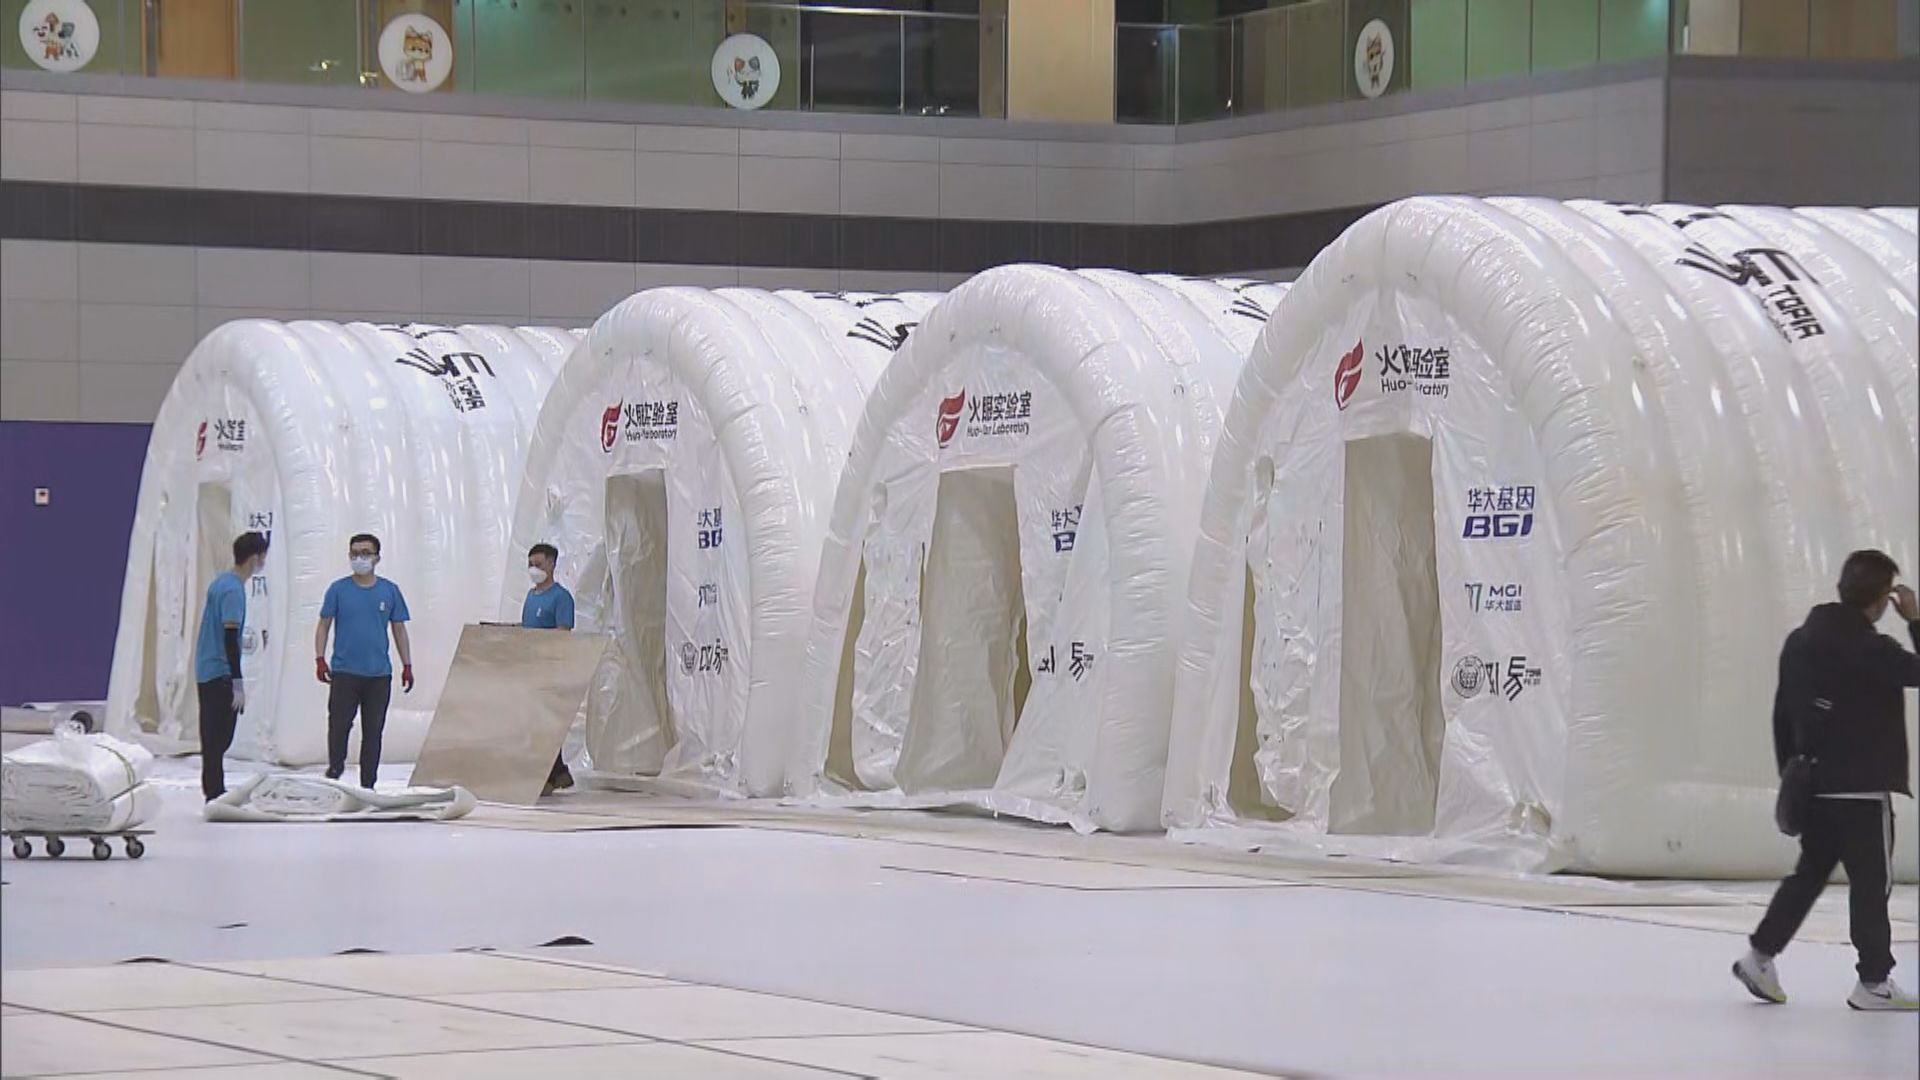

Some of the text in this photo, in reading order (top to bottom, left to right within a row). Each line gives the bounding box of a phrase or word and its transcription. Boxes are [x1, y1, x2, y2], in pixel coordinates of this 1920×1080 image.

[1768, 284, 1825, 340] TOPIA
[1467, 486, 1535, 513] 华大基因
[1462, 513, 1534, 538] BGI
[1489, 584, 1522, 597] MGI
